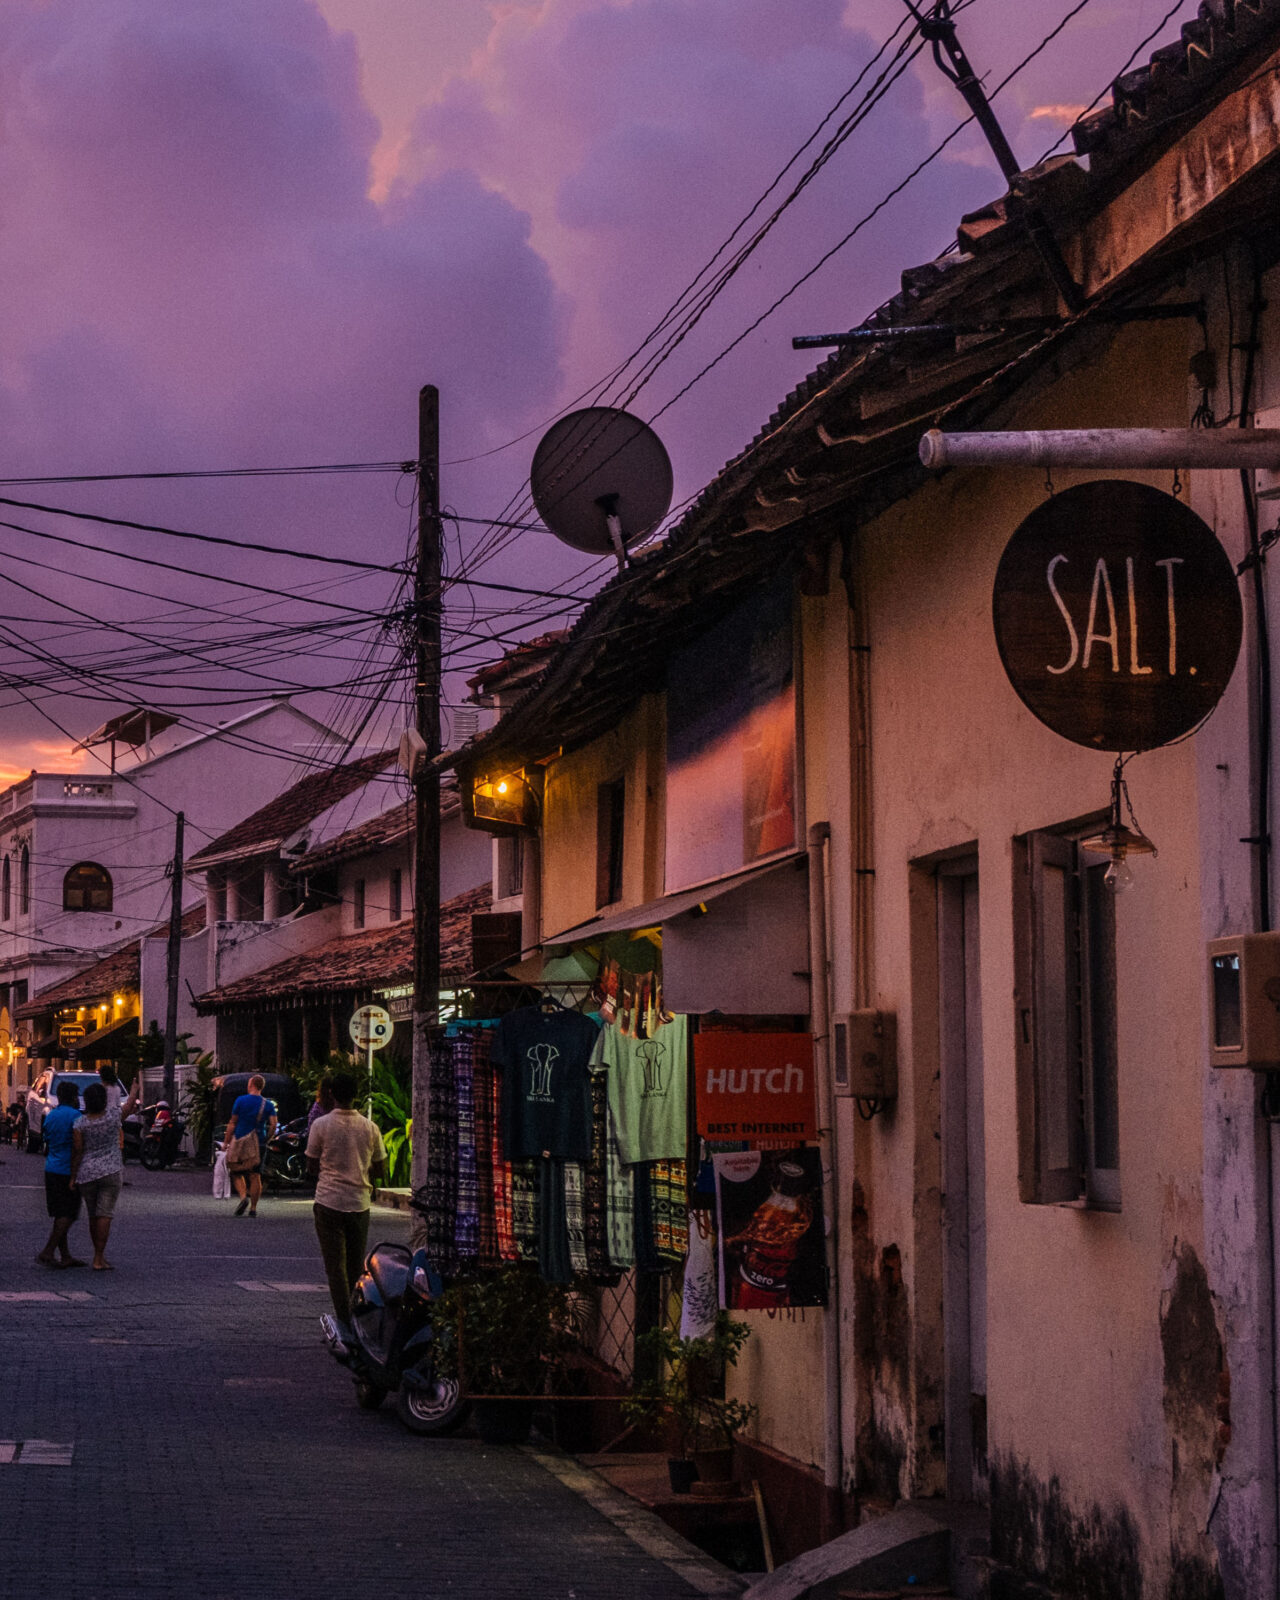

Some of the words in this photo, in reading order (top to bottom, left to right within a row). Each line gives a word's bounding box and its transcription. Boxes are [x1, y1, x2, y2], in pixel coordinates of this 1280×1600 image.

[1046, 553, 1198, 676] SALT.
[707, 1122, 738, 1134] BEST
[742, 1122, 805, 1134] INTERNET
[750, 1270, 775, 1286] zero
